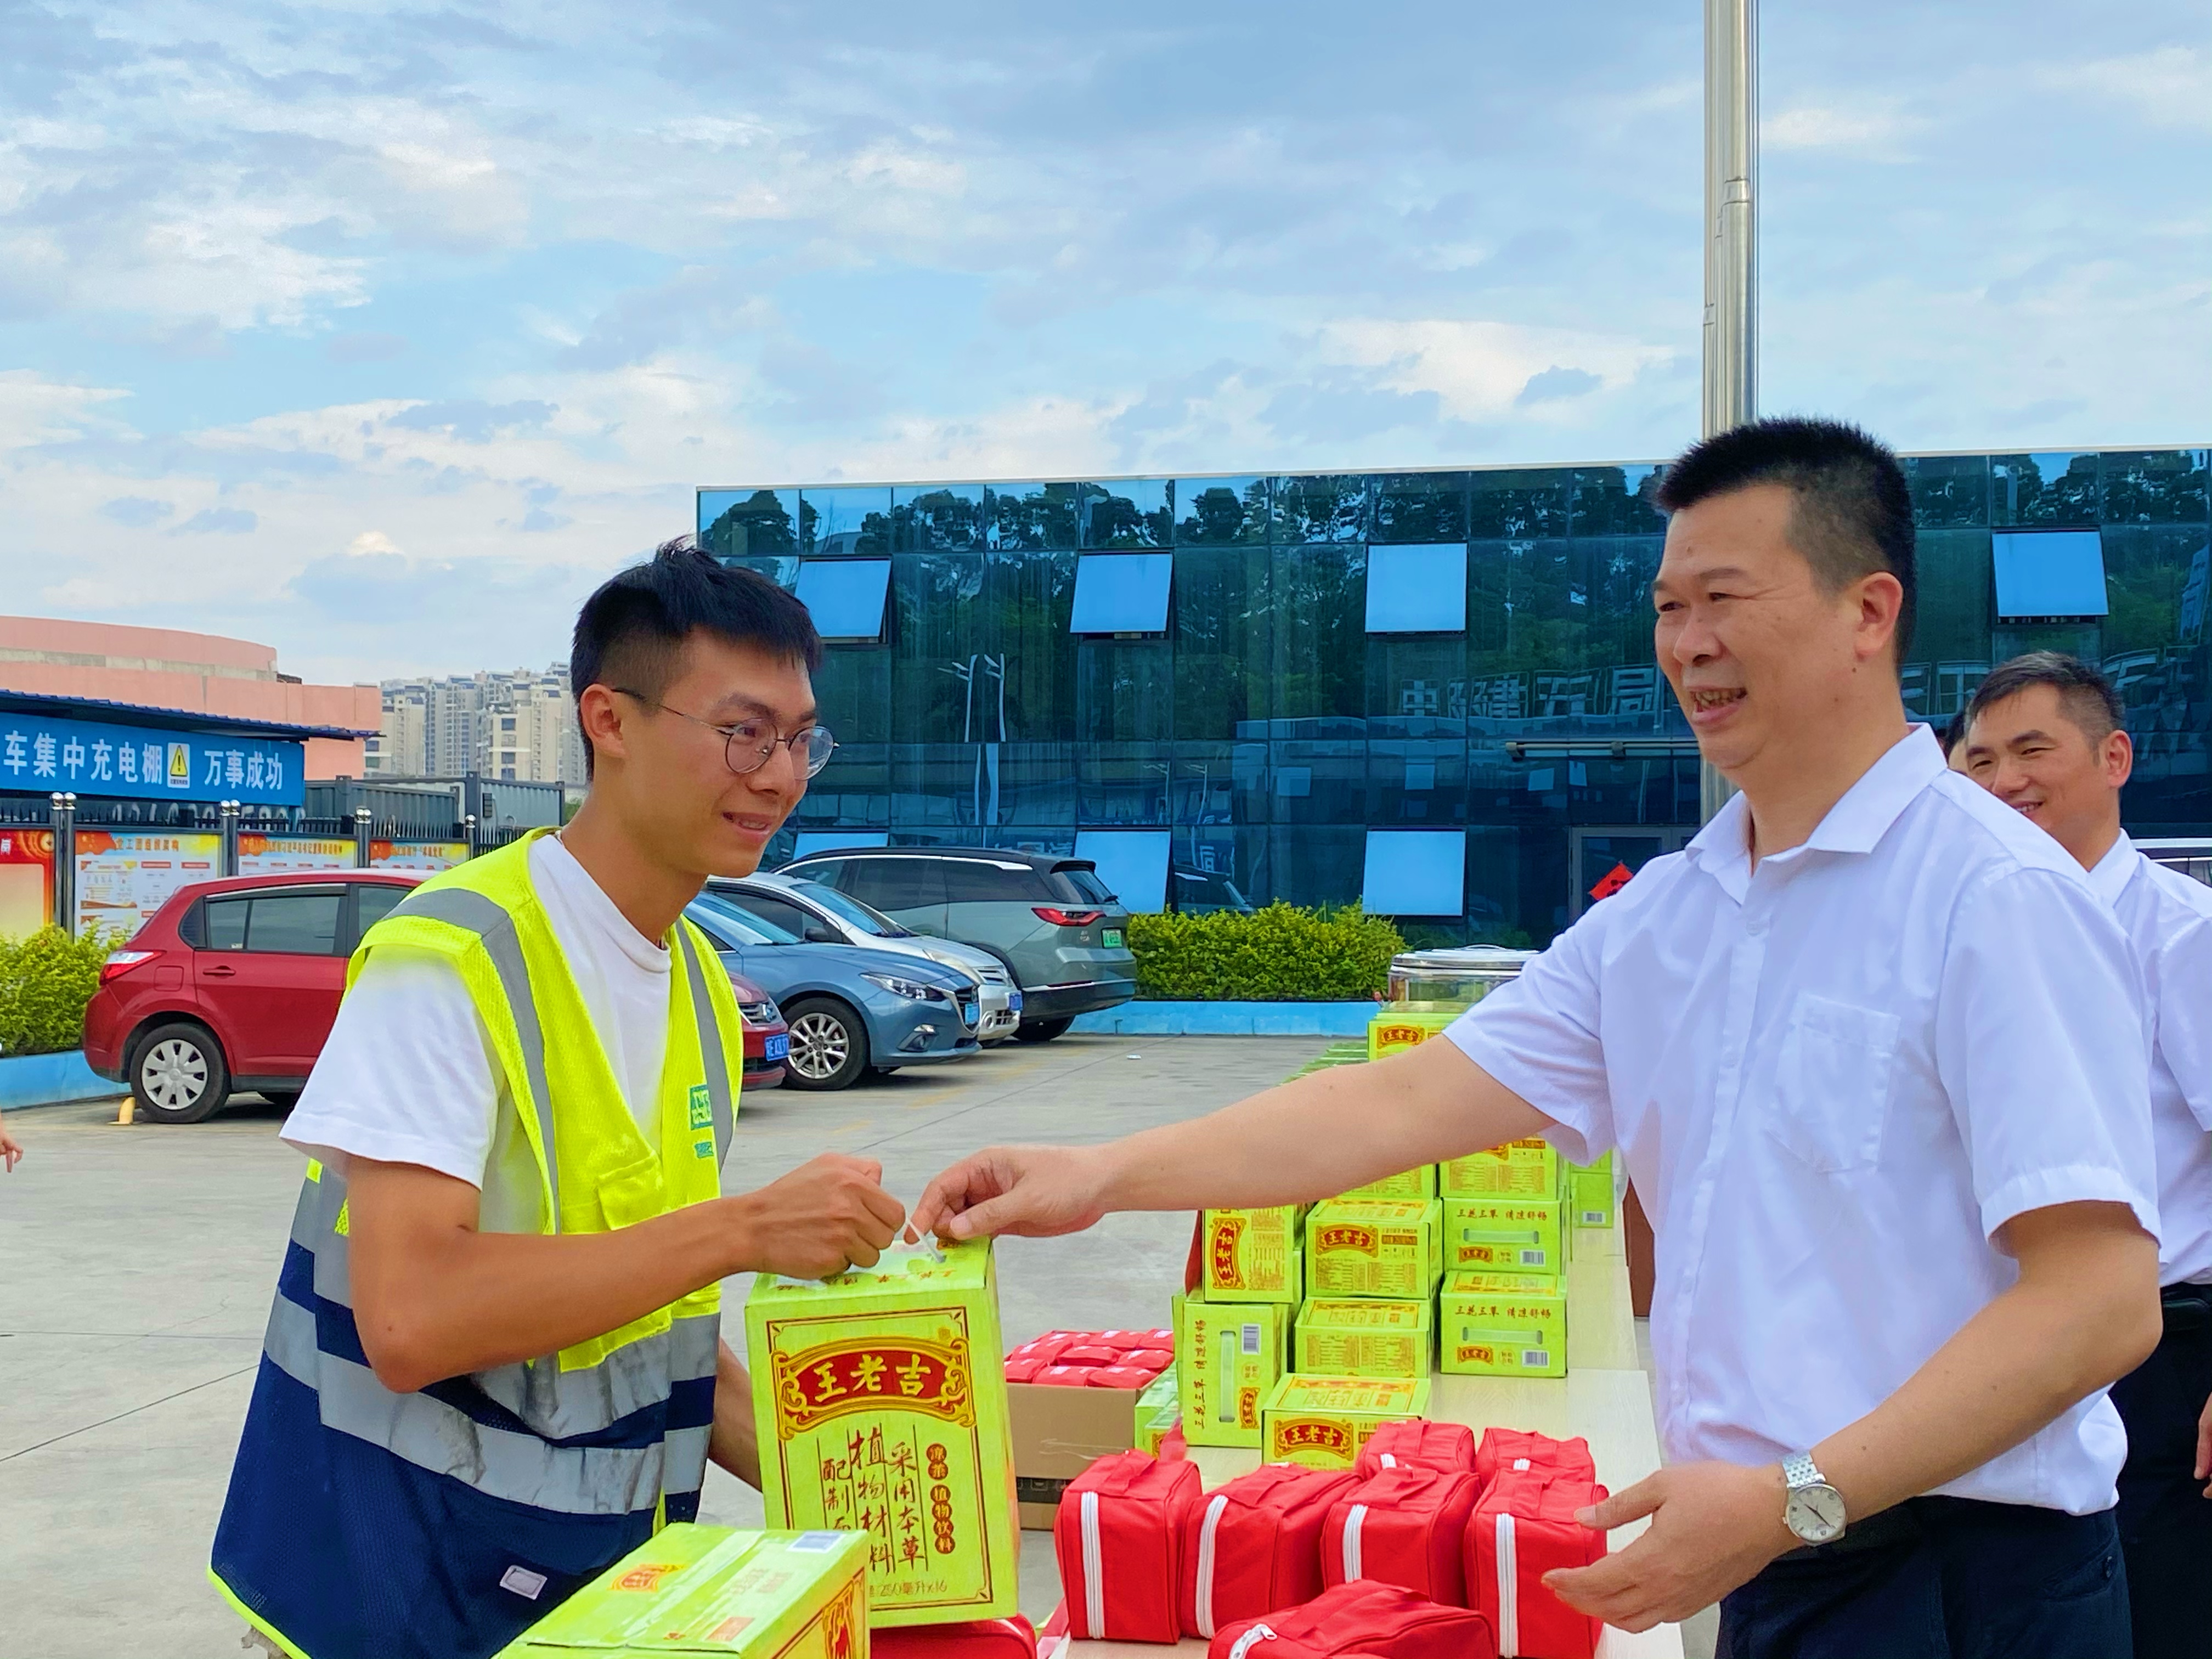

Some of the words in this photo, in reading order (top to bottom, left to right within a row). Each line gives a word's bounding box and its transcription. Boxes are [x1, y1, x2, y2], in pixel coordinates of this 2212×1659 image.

[4, 730, 162, 785] 车集中充电棚
[204, 749, 283, 791] 万事成功
[1217, 1232, 1233, 1275] 王老吉
[1328, 1229, 1367, 1246] 王老吉
[813, 1353, 932, 1403] 王老吉
[1290, 1425, 1339, 1446] 王老吉
[849, 1427, 893, 1576] 植物材料
[888, 1441, 926, 1572] 采用本草
[930, 1484, 956, 1554] 植物饮料
